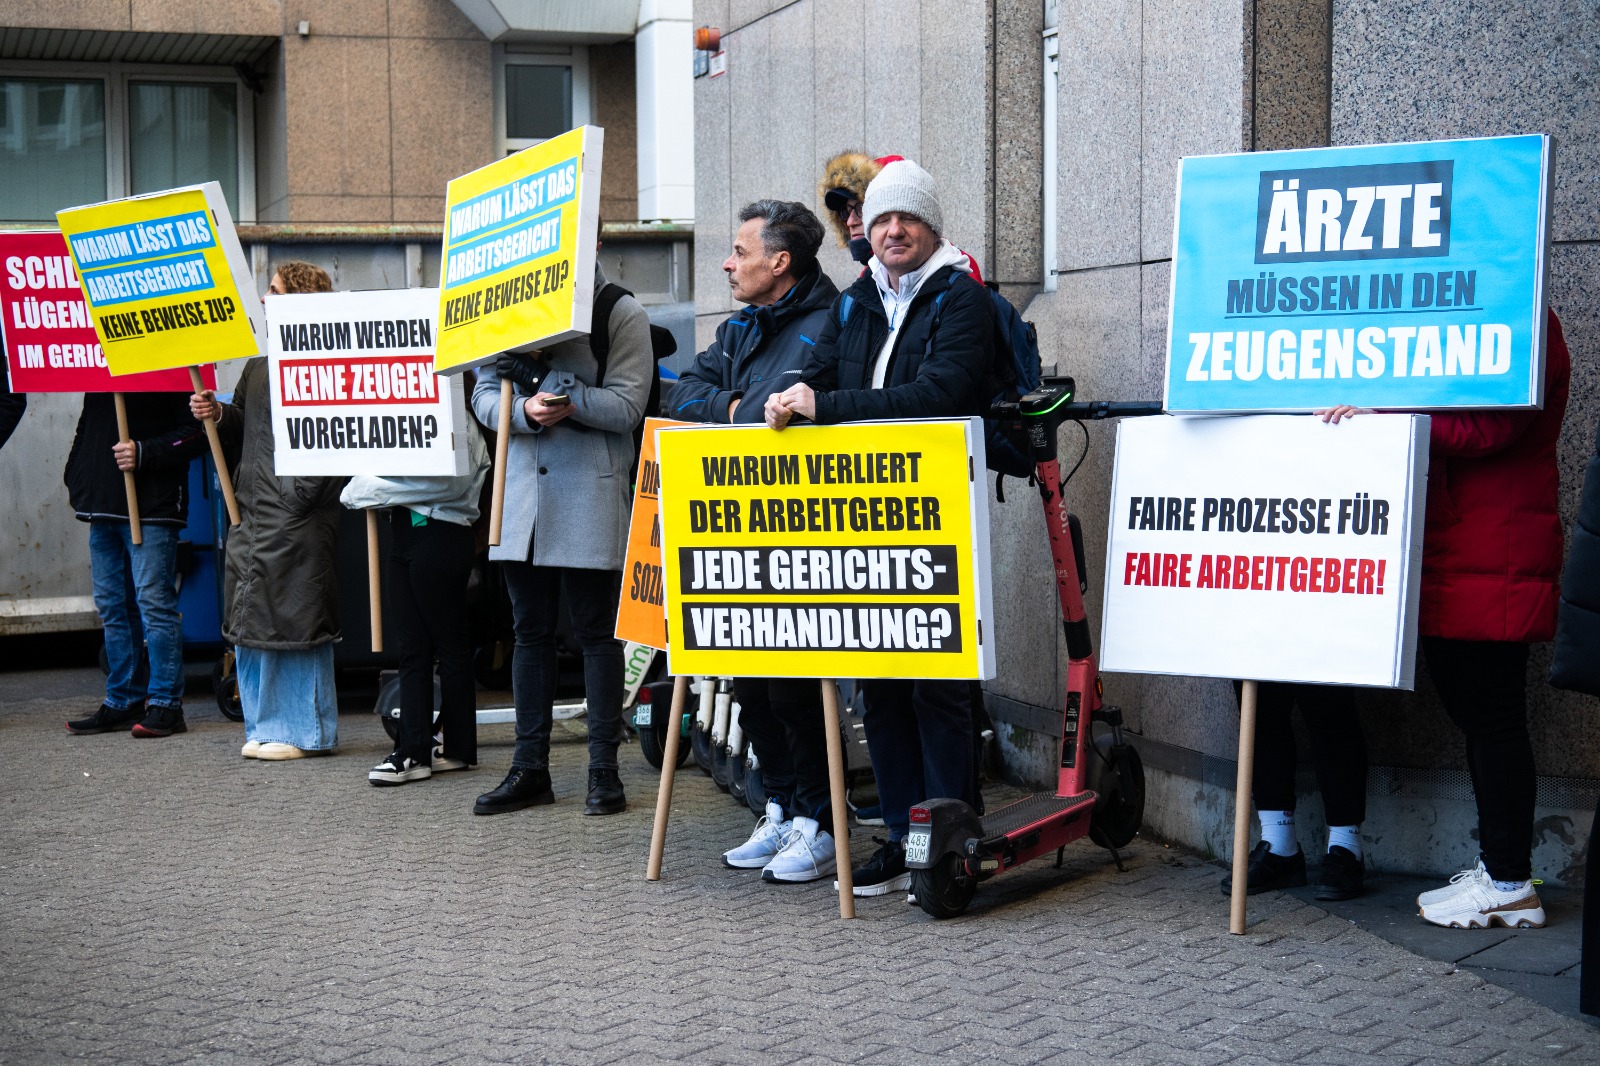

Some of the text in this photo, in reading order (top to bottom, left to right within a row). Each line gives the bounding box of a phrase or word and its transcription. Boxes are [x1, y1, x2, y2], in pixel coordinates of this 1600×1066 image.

[451, 165, 575, 239] WARUM LÄSST DAS
[1262, 179, 1443, 255] ÄRZTE
[72, 216, 211, 264] WARUM LÄSST DAS
[447, 217, 560, 283] ARBEITSGERICHT
[6, 256, 81, 290] SCHL
[87, 259, 209, 303] ARBEITSGERICHT
[444, 259, 569, 328] KEINE BEWEISE ZU?
[1226, 270, 1476, 314] MÜSSEN IN DEN
[100, 296, 236, 339] KEINE BEWEISE ZU?
[280, 318, 432, 351] WARUM WERDEN
[18, 343, 108, 369] IM GERIC
[1185, 323, 1511, 382] ZEUGENSTAND
[283, 362, 436, 402] KEINE ZEUGEN
[286, 414, 438, 450] VORGELADEN?
[702, 452, 922, 487] WARUM VERLIERT
[689, 496, 942, 534] DER ARBEITGEBER
[1128, 492, 1390, 535] FAIRE PROZESSE FÜR
[691, 548, 947, 591] JEDE GERICHTS-
[1123, 552, 1387, 595] FAIRE ARBEITGEBER!
[690, 607, 952, 650] VERHANDLUNG?
[910, 834, 927, 847] 483
